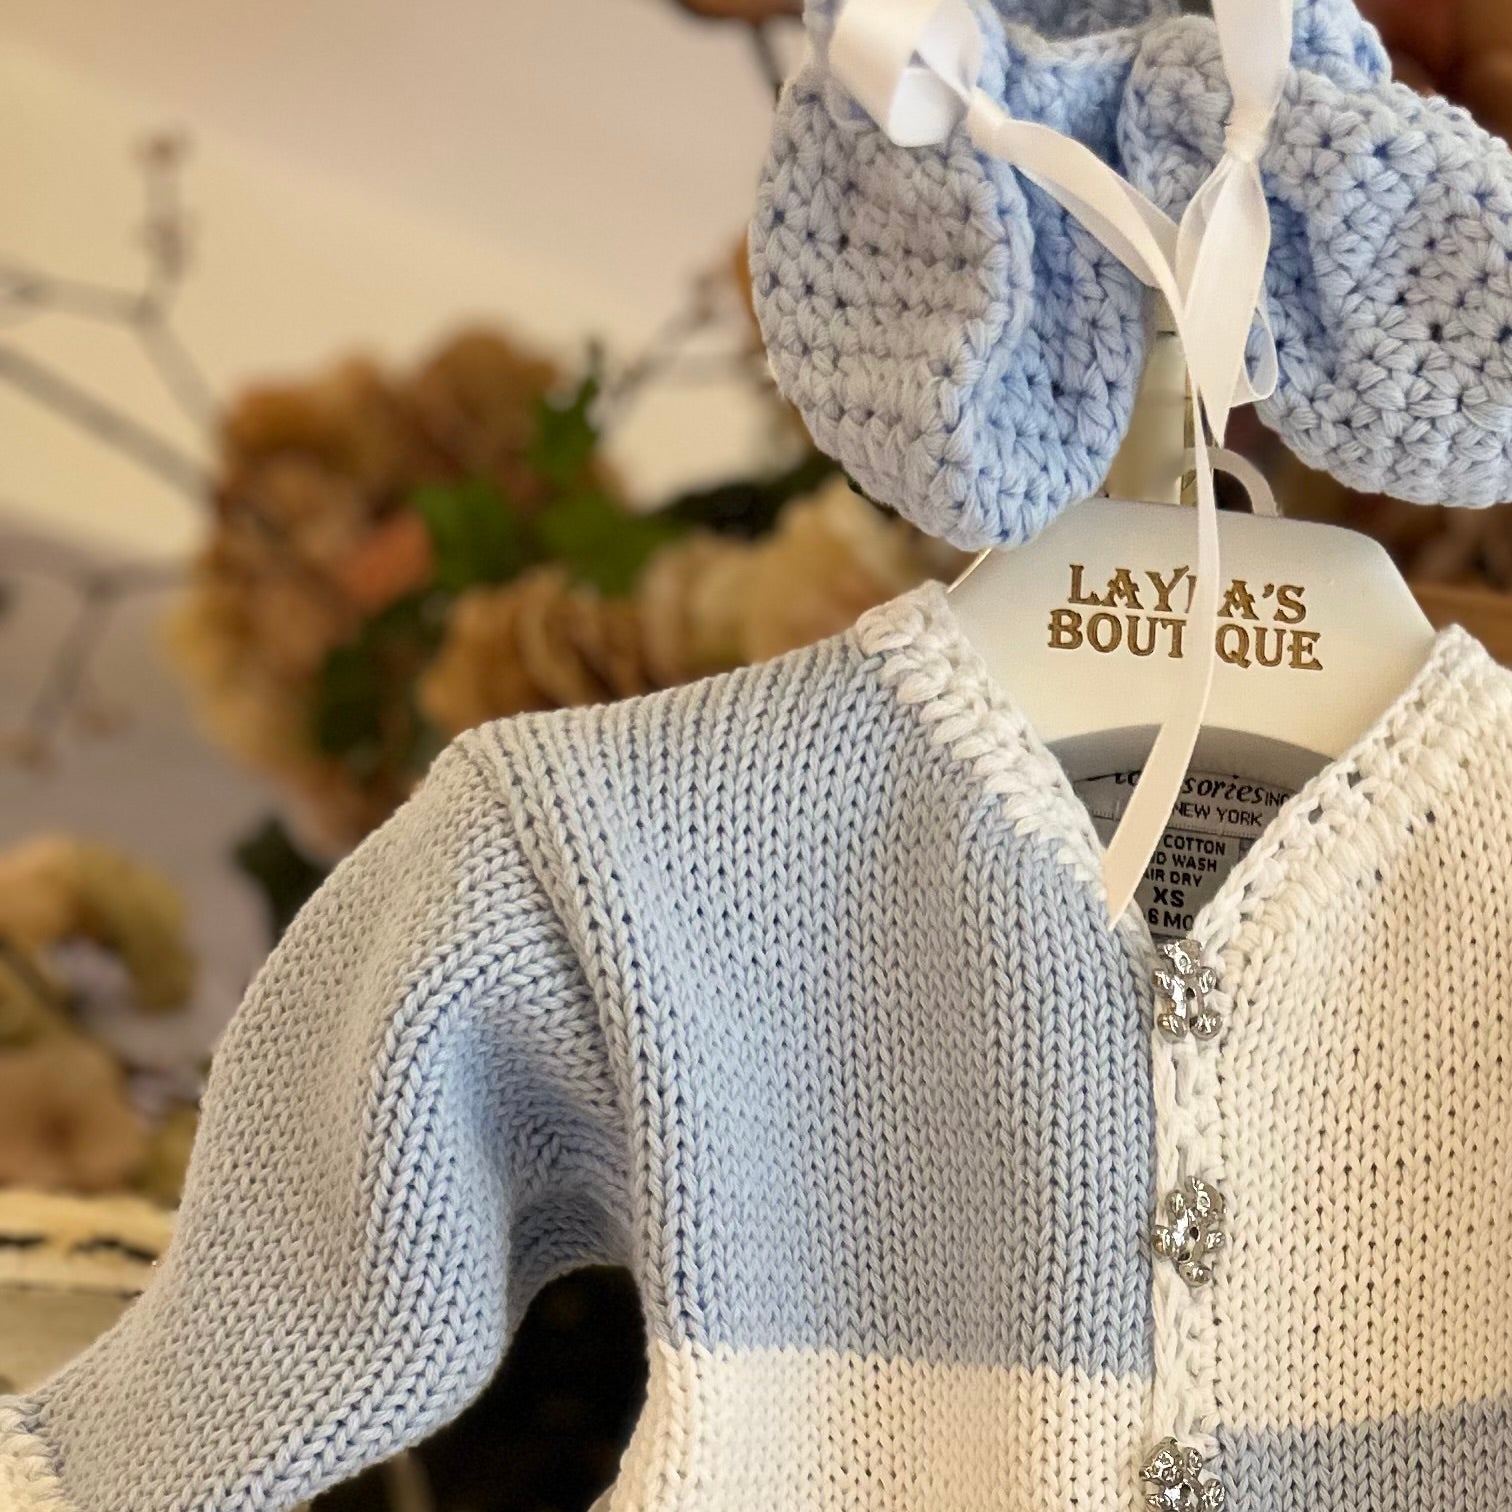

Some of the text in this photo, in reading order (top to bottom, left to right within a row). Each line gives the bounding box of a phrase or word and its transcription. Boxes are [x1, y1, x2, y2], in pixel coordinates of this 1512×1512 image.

[1068, 564, 1306, 624] LAYA'S
[1047, 608, 1324, 670] BOUTQUE
[1216, 806, 1263, 828] YORK
[1163, 834, 1226, 856] COTTON
[1172, 853, 1217, 873] WASH
[1170, 871, 1203, 888] DRY
[1153, 886, 1185, 908] XS
[1145, 907, 1159, 925] 6
